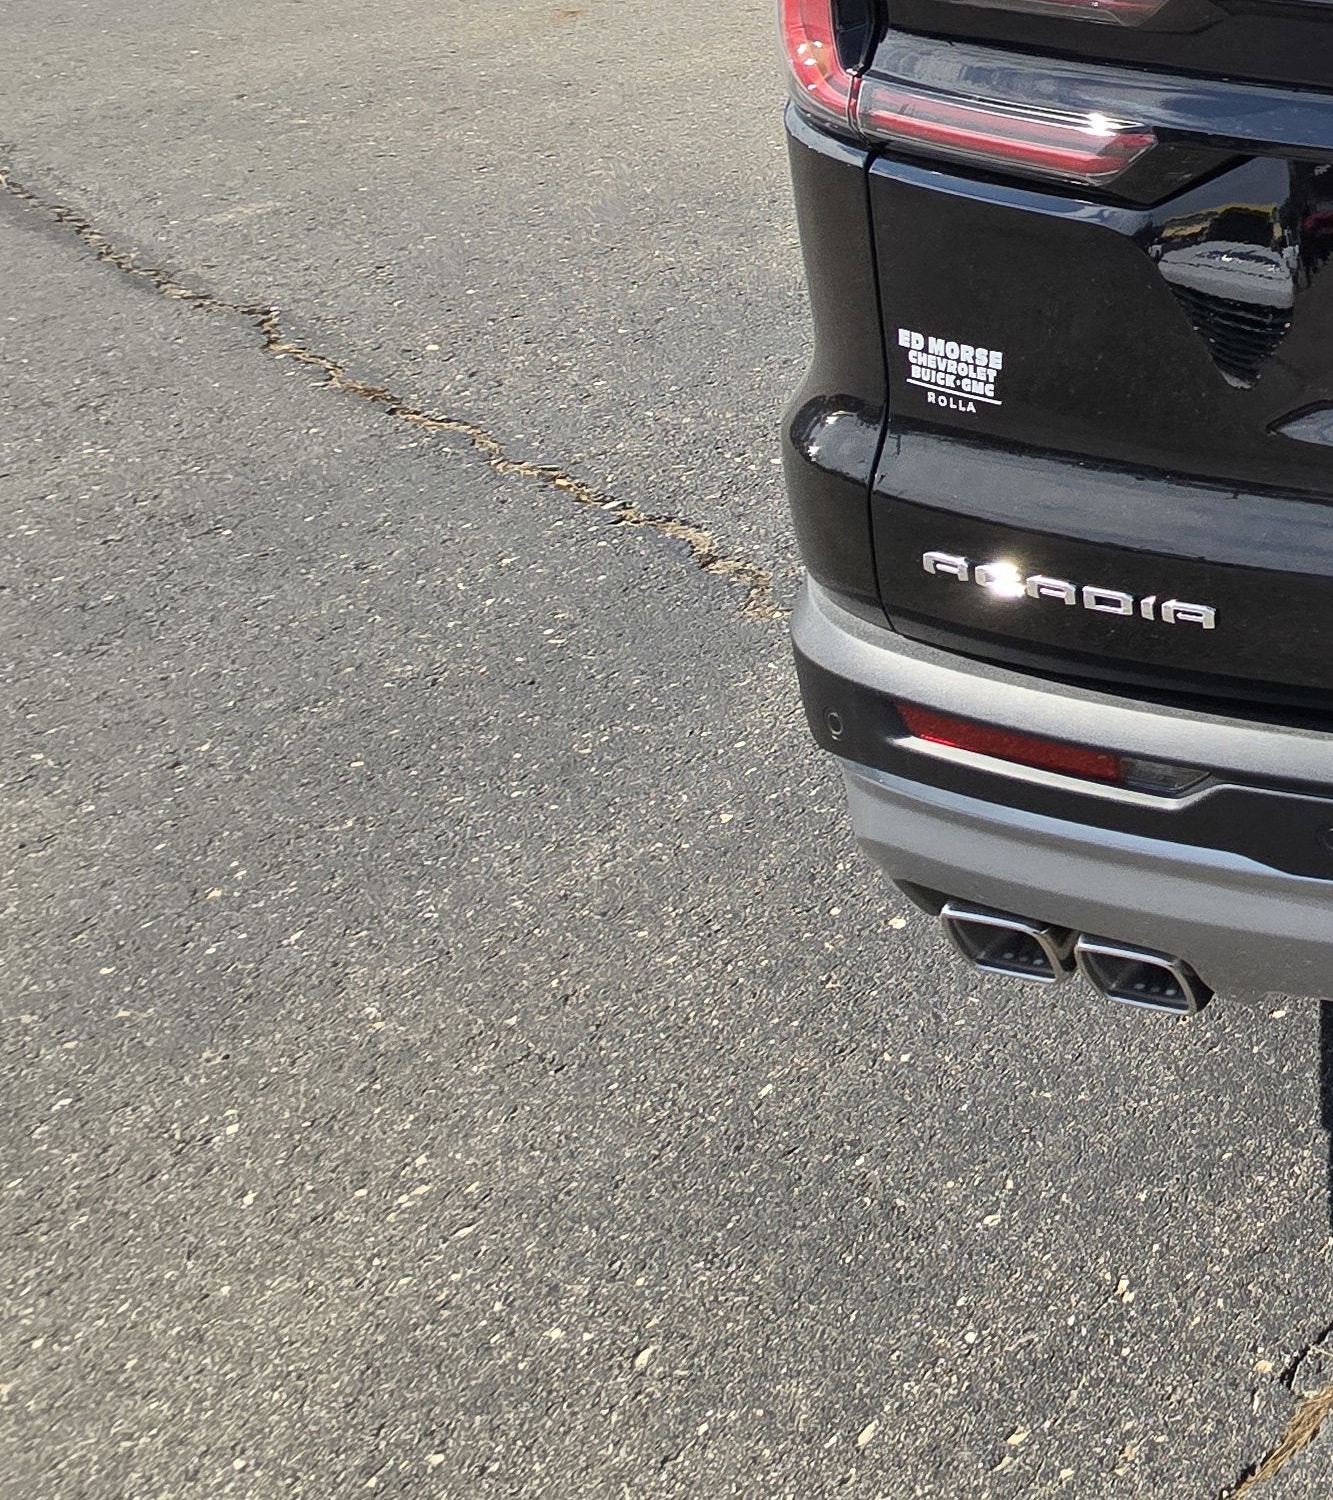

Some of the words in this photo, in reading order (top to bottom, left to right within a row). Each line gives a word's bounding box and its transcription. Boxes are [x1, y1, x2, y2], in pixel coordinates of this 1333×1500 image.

[898, 328, 925, 351] ED
[928, 336, 1003, 370] MORSE
[908, 350, 997, 382] CHEVROLET
[927, 392, 977, 413] ROLLA
